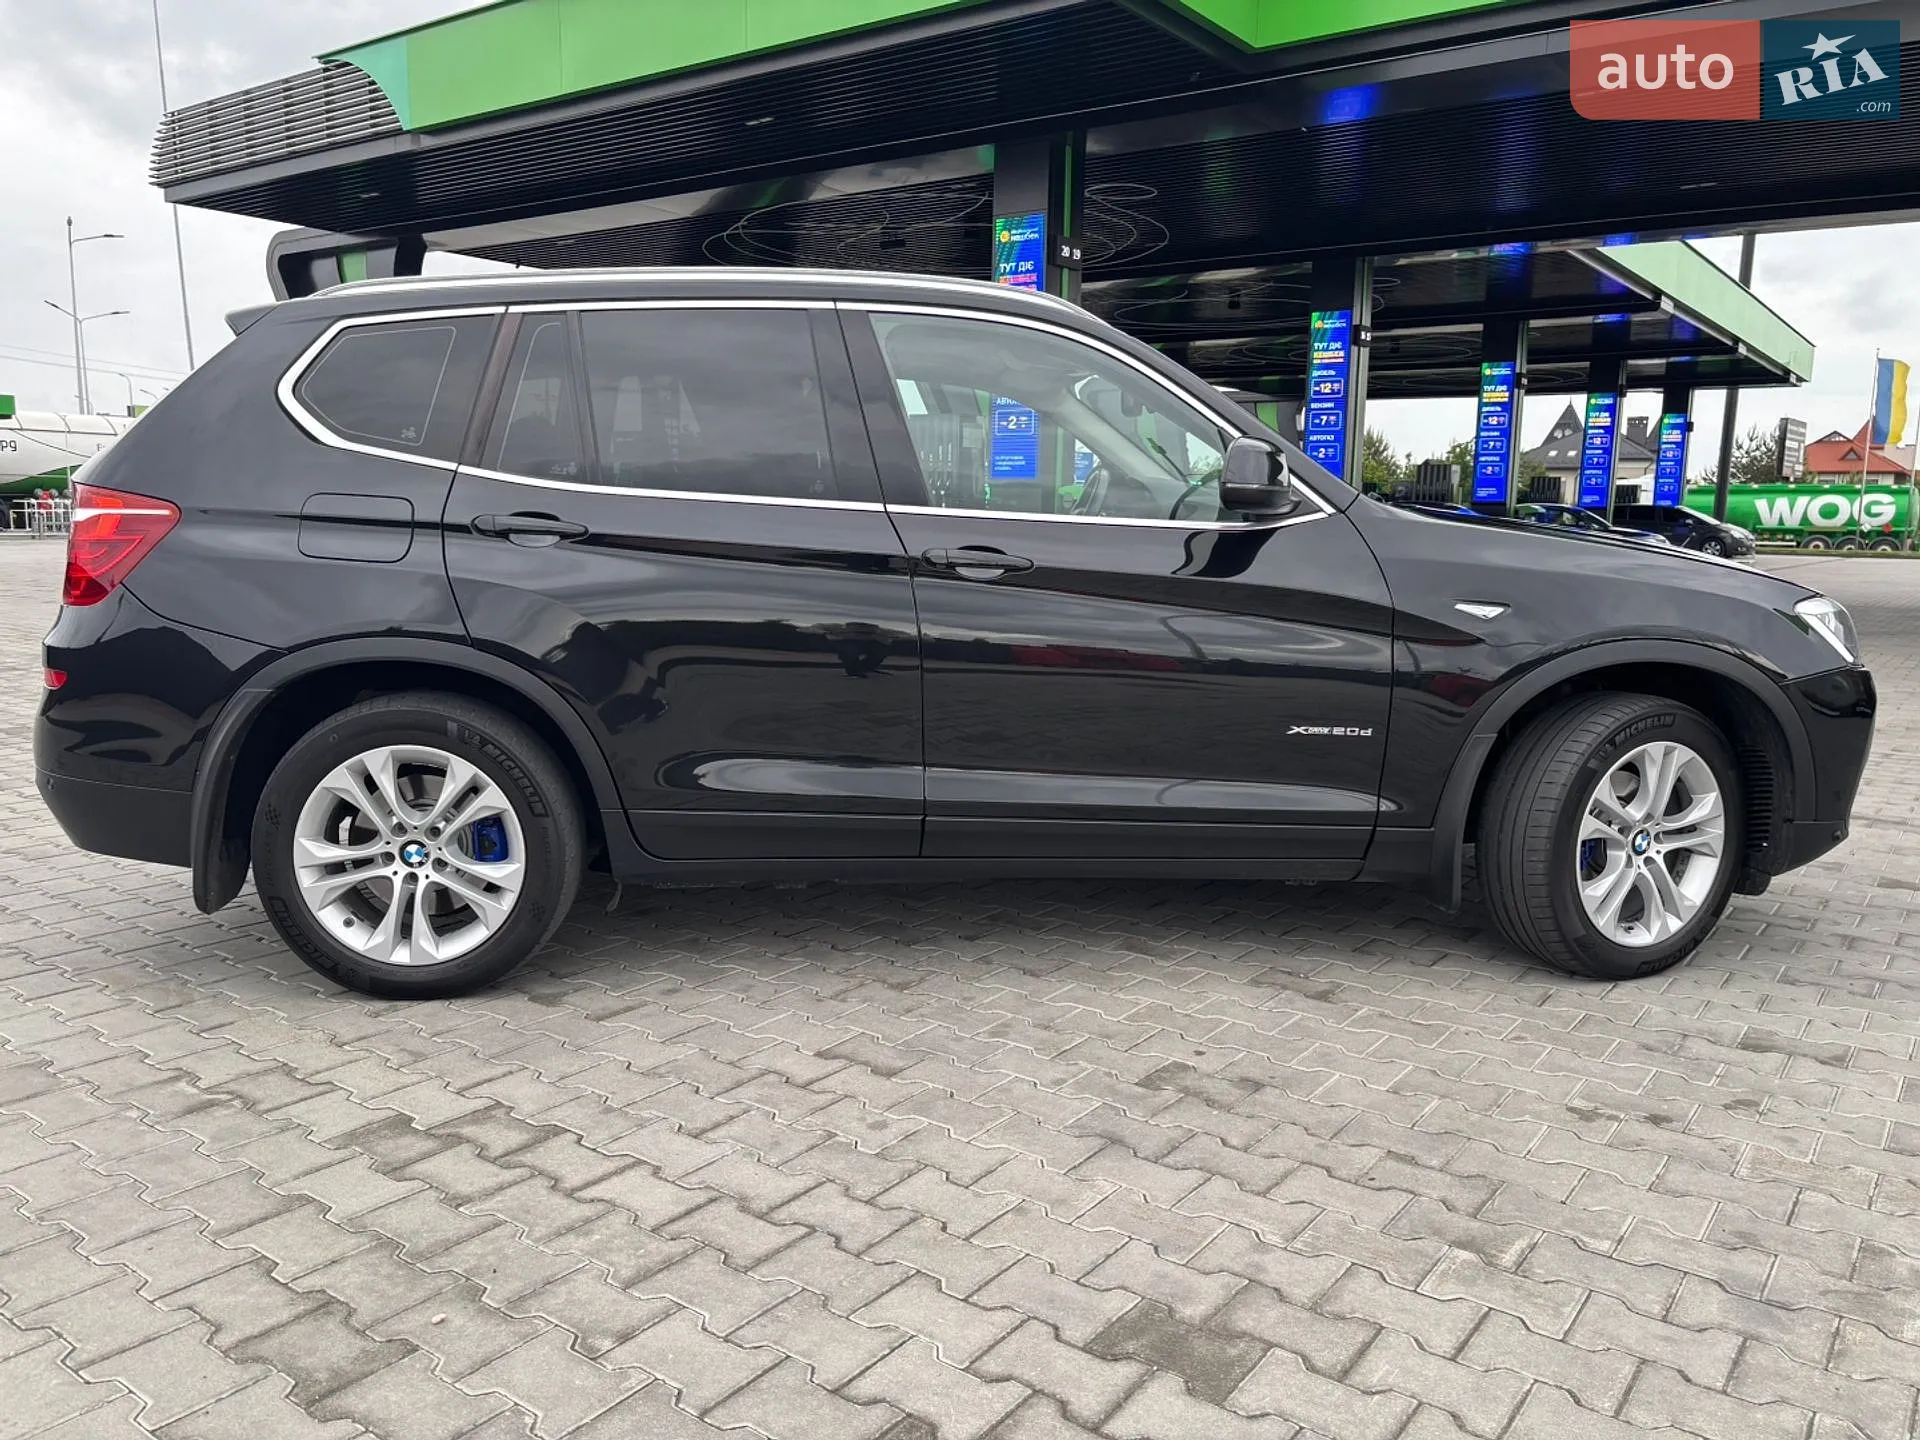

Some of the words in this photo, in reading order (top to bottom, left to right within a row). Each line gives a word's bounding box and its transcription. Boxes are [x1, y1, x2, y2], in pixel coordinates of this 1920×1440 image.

[999, 263, 1017, 273] ТУТ
[1018, 261, 1035, 272] ДІЄ
[1314, 342, 1328, 350] ТУТ
[1313, 382, 1332, 393] -12
[1000, 415, 1017, 430] -2
[1313, 415, 1328, 426] -7
[1753, 493, 1897, 529] WOG
[1613, 712, 1677, 748] MICHELIN
